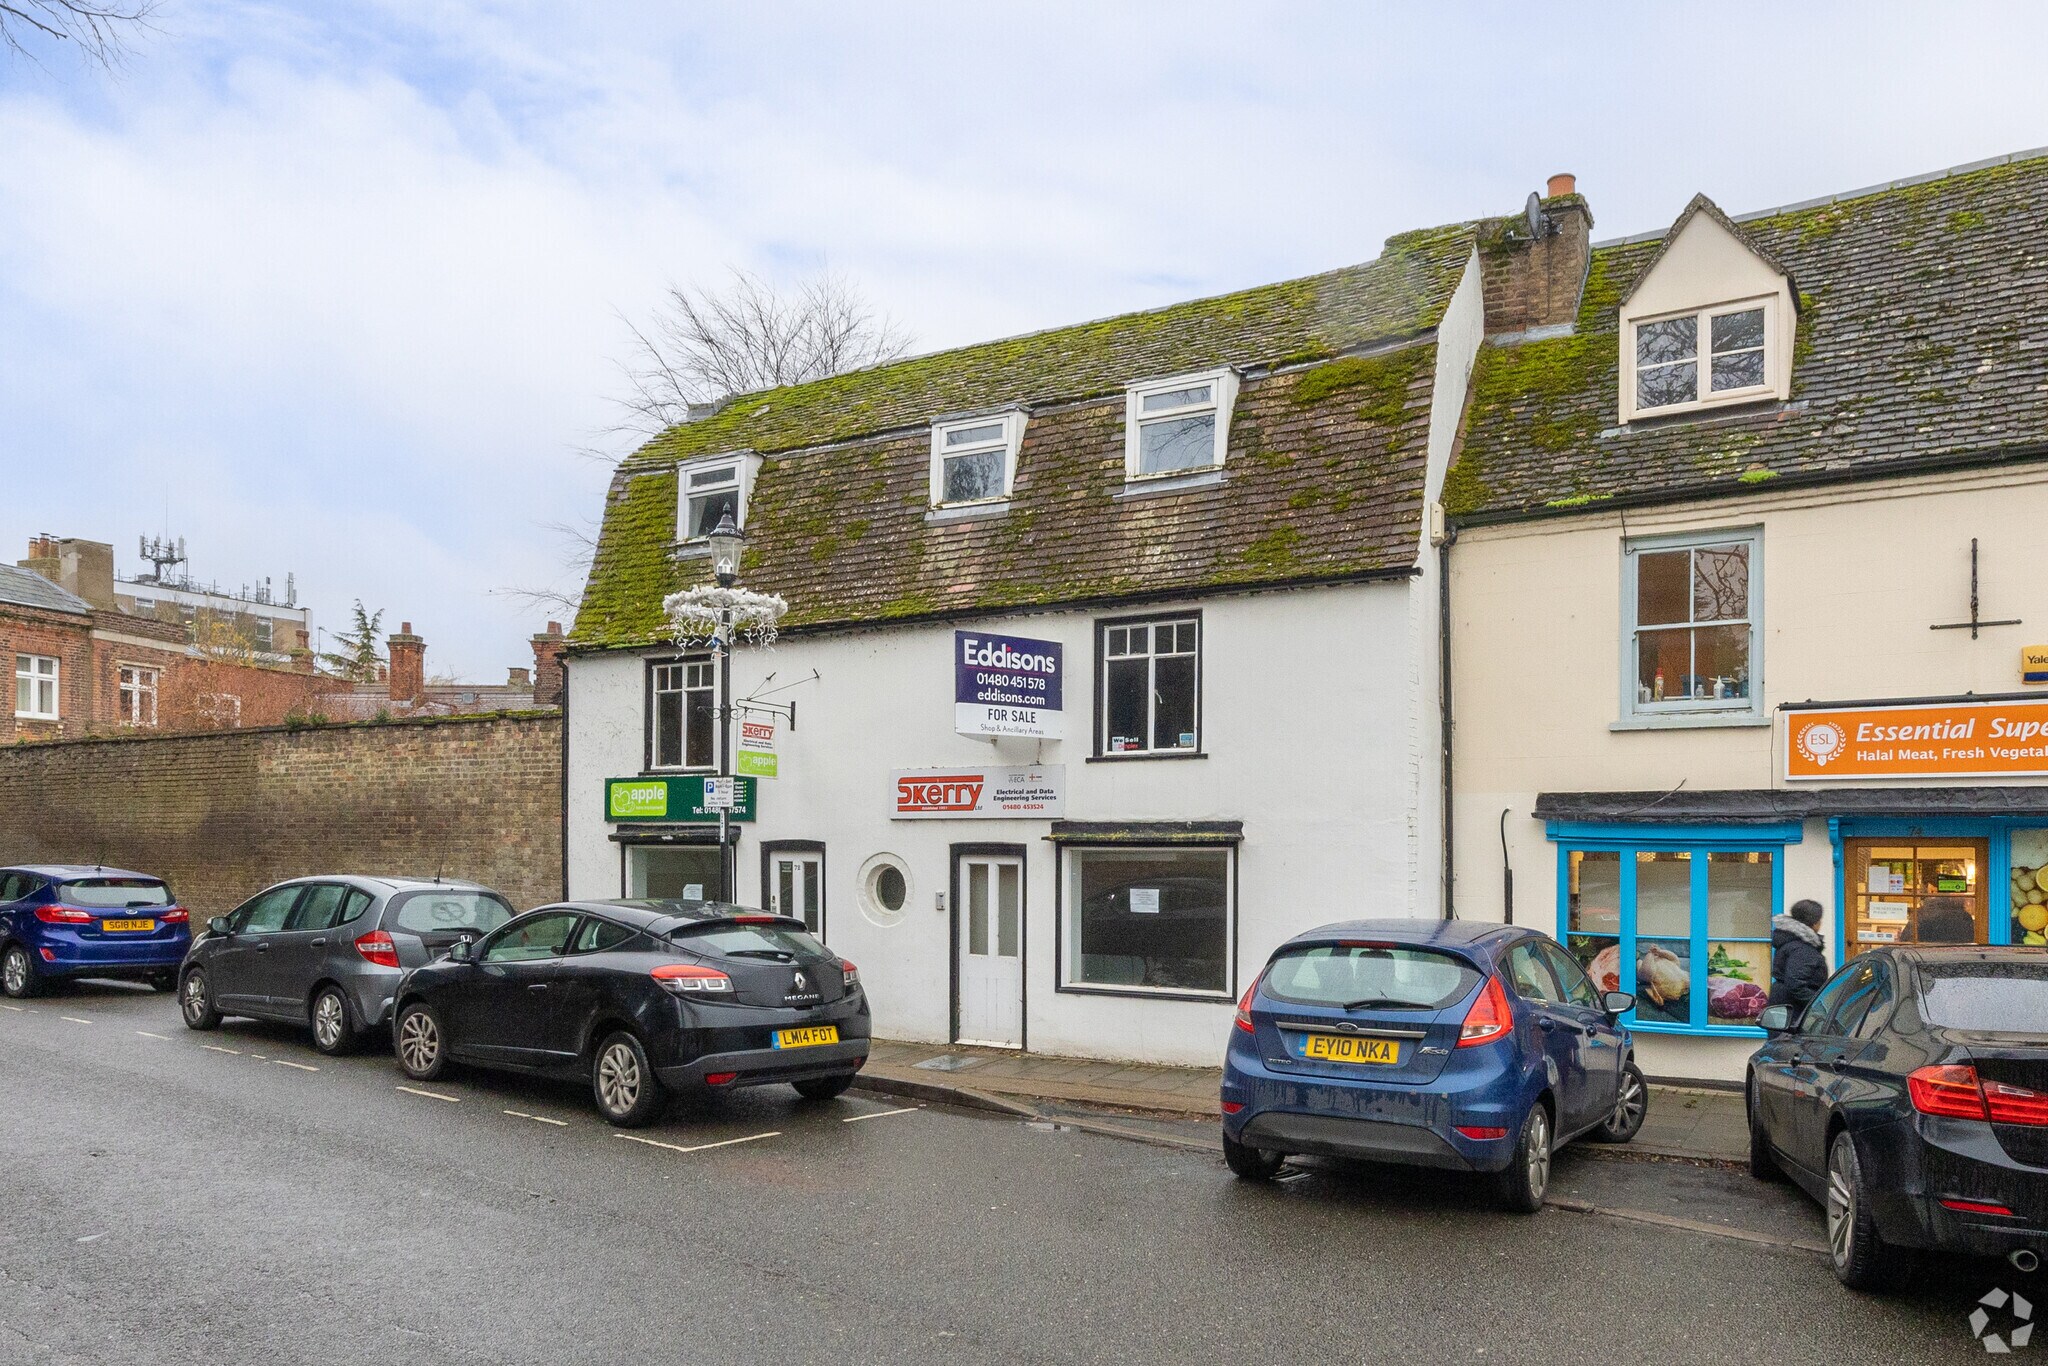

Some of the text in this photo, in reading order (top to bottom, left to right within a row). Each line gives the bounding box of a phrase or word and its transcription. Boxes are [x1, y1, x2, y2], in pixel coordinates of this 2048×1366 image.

[963, 639, 1056, 674] Eddisons
[976, 673, 1009, 687] 01480
[977, 688, 1046, 705] eddisons.com
[988, 709, 1036, 723] FOR SALE
[742, 723, 774, 739] Skerry
[980, 724, 996, 732] Shop
[1002, 727, 1027, 735] Ancillary
[1856, 718, 1976, 742] Essential
[1810, 733, 1833, 745] ESL
[1857, 749, 1893, 761] Halal
[1898, 748, 1938, 762] Meat,
[1942, 747, 1985, 759] Fresh
[631, 786, 665, 804] apple
[897, 783, 984, 811] Skerry
[108, 920, 149, 929] SG18 NJE
[782, 1028, 832, 1045] LM14 FOT
[1313, 1037, 1391, 1061] EY10 NKA
